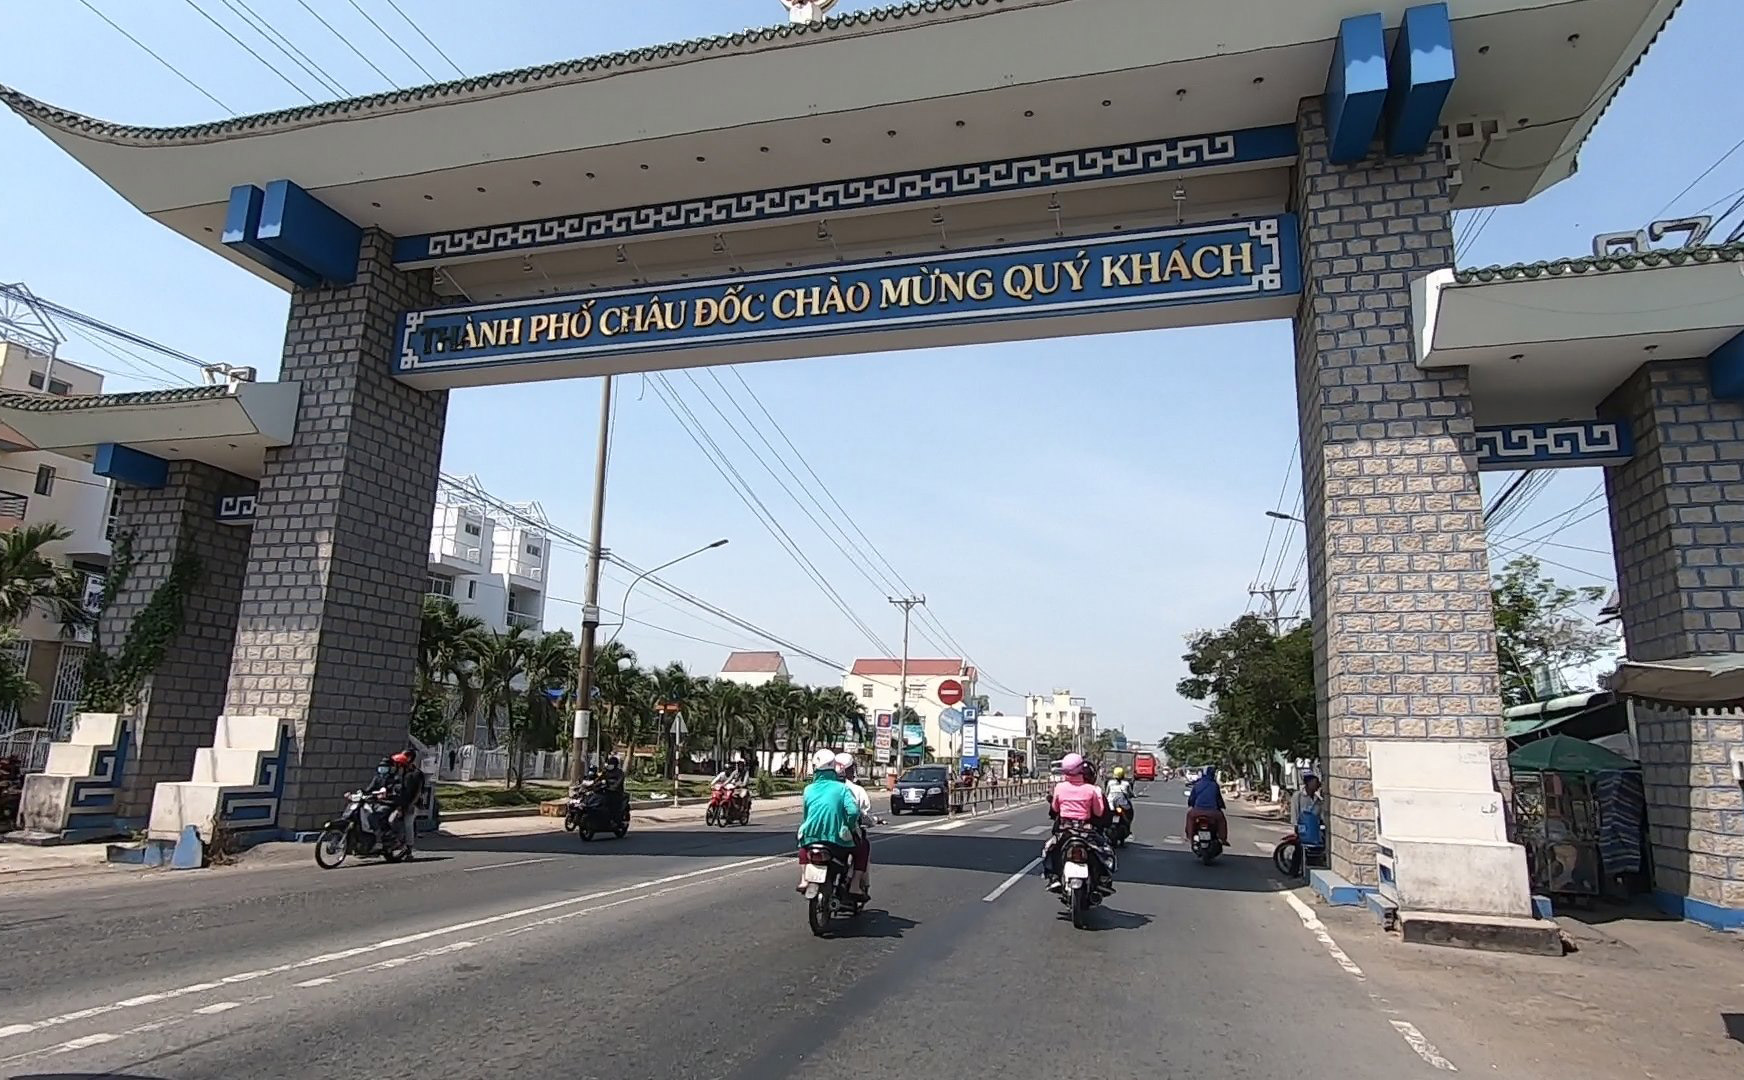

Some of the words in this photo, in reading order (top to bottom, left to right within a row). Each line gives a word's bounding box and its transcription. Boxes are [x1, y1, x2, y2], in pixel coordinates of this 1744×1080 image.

[422, 315, 522, 354] THÀNH
[529, 299, 596, 342] PHỐ
[599, 294, 687, 336] CHÂU
[694, 284, 765, 327] ĐỐC
[771, 275, 871, 320] CHÀO
[879, 265, 994, 308] MỪNG
[1002, 250, 1090, 300] QUÝ
[1100, 238, 1254, 287] KHÁCH
